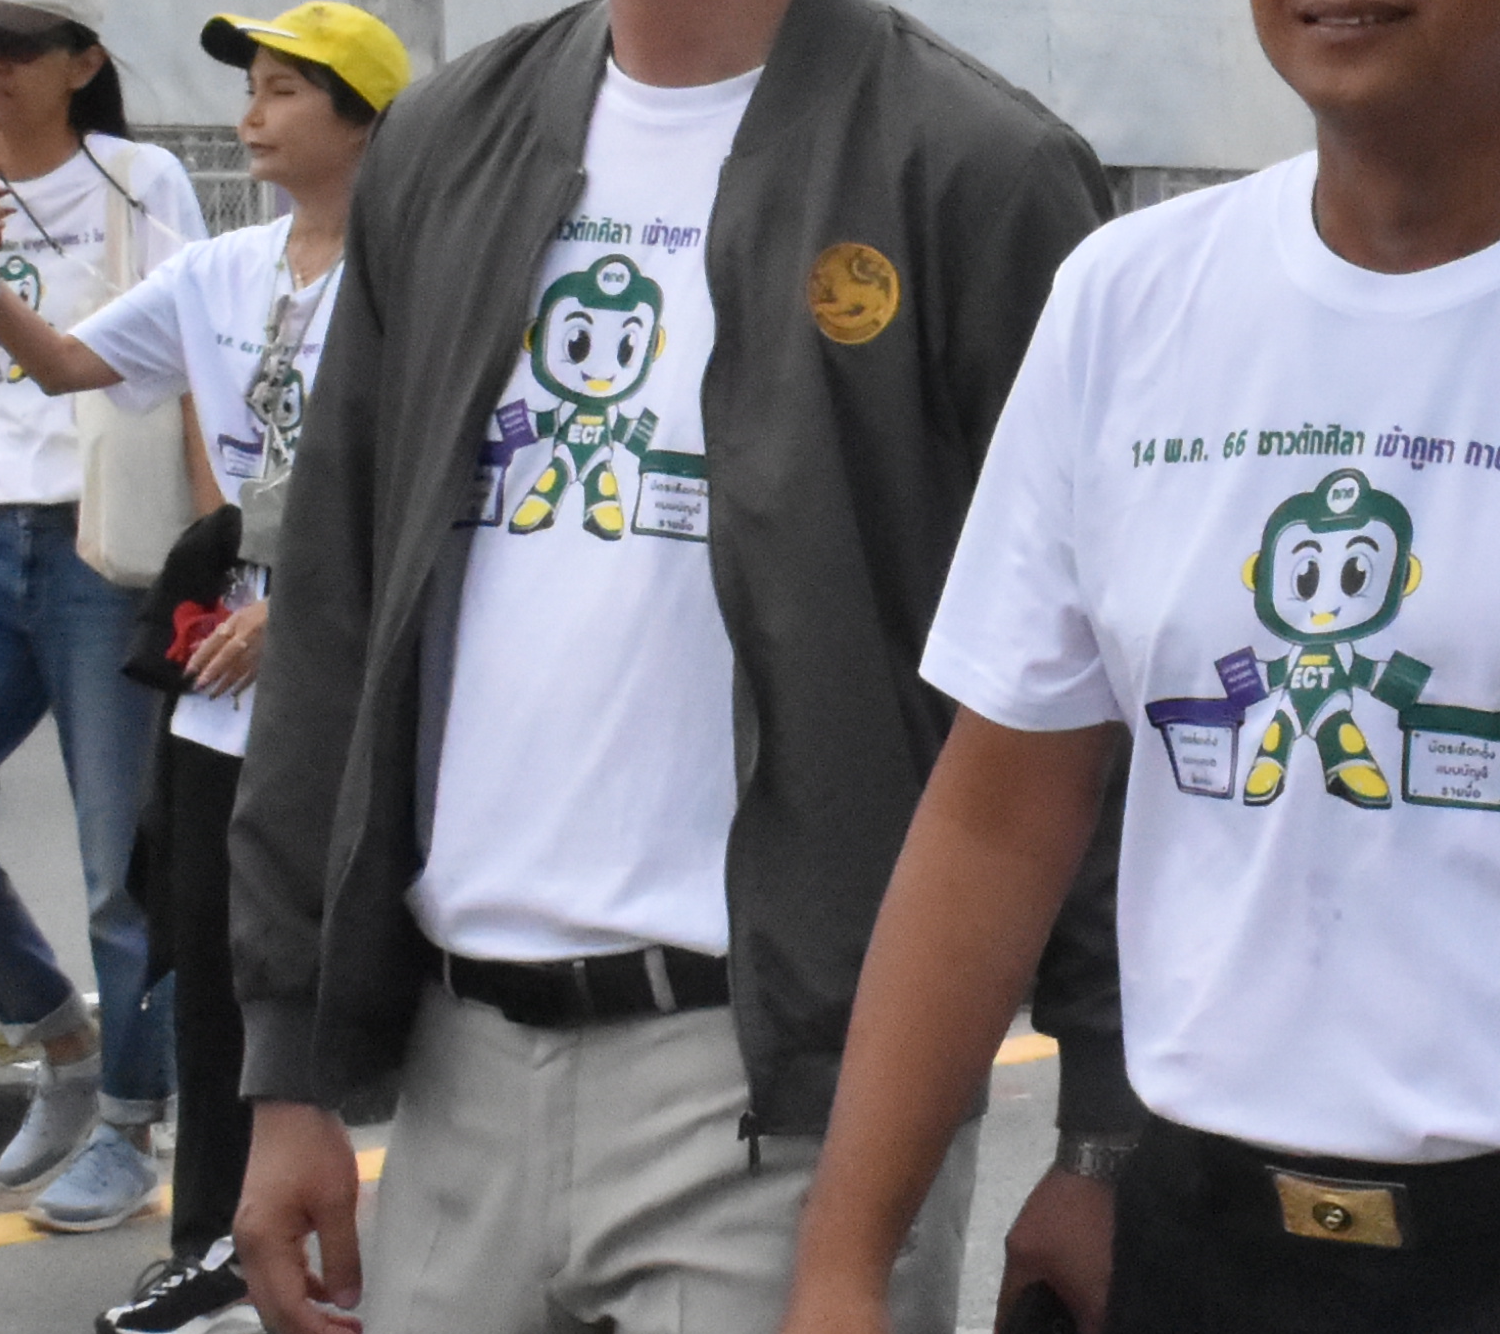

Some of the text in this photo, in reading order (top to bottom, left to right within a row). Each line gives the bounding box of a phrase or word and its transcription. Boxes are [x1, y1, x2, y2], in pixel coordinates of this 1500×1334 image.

[556, 214, 701, 254] าวตักศิลา เข้าคูหา
[567, 424, 606, 445] ECT
[1131, 438, 1157, 468] 14
[1163, 437, 1209, 464] พ.ค.
[1222, 429, 1248, 460] 66
[1257, 422, 1366, 457] ชาวตักศิลา
[1374, 424, 1456, 472] เข้าคูหา
[1290, 666, 1334, 689] ECT
